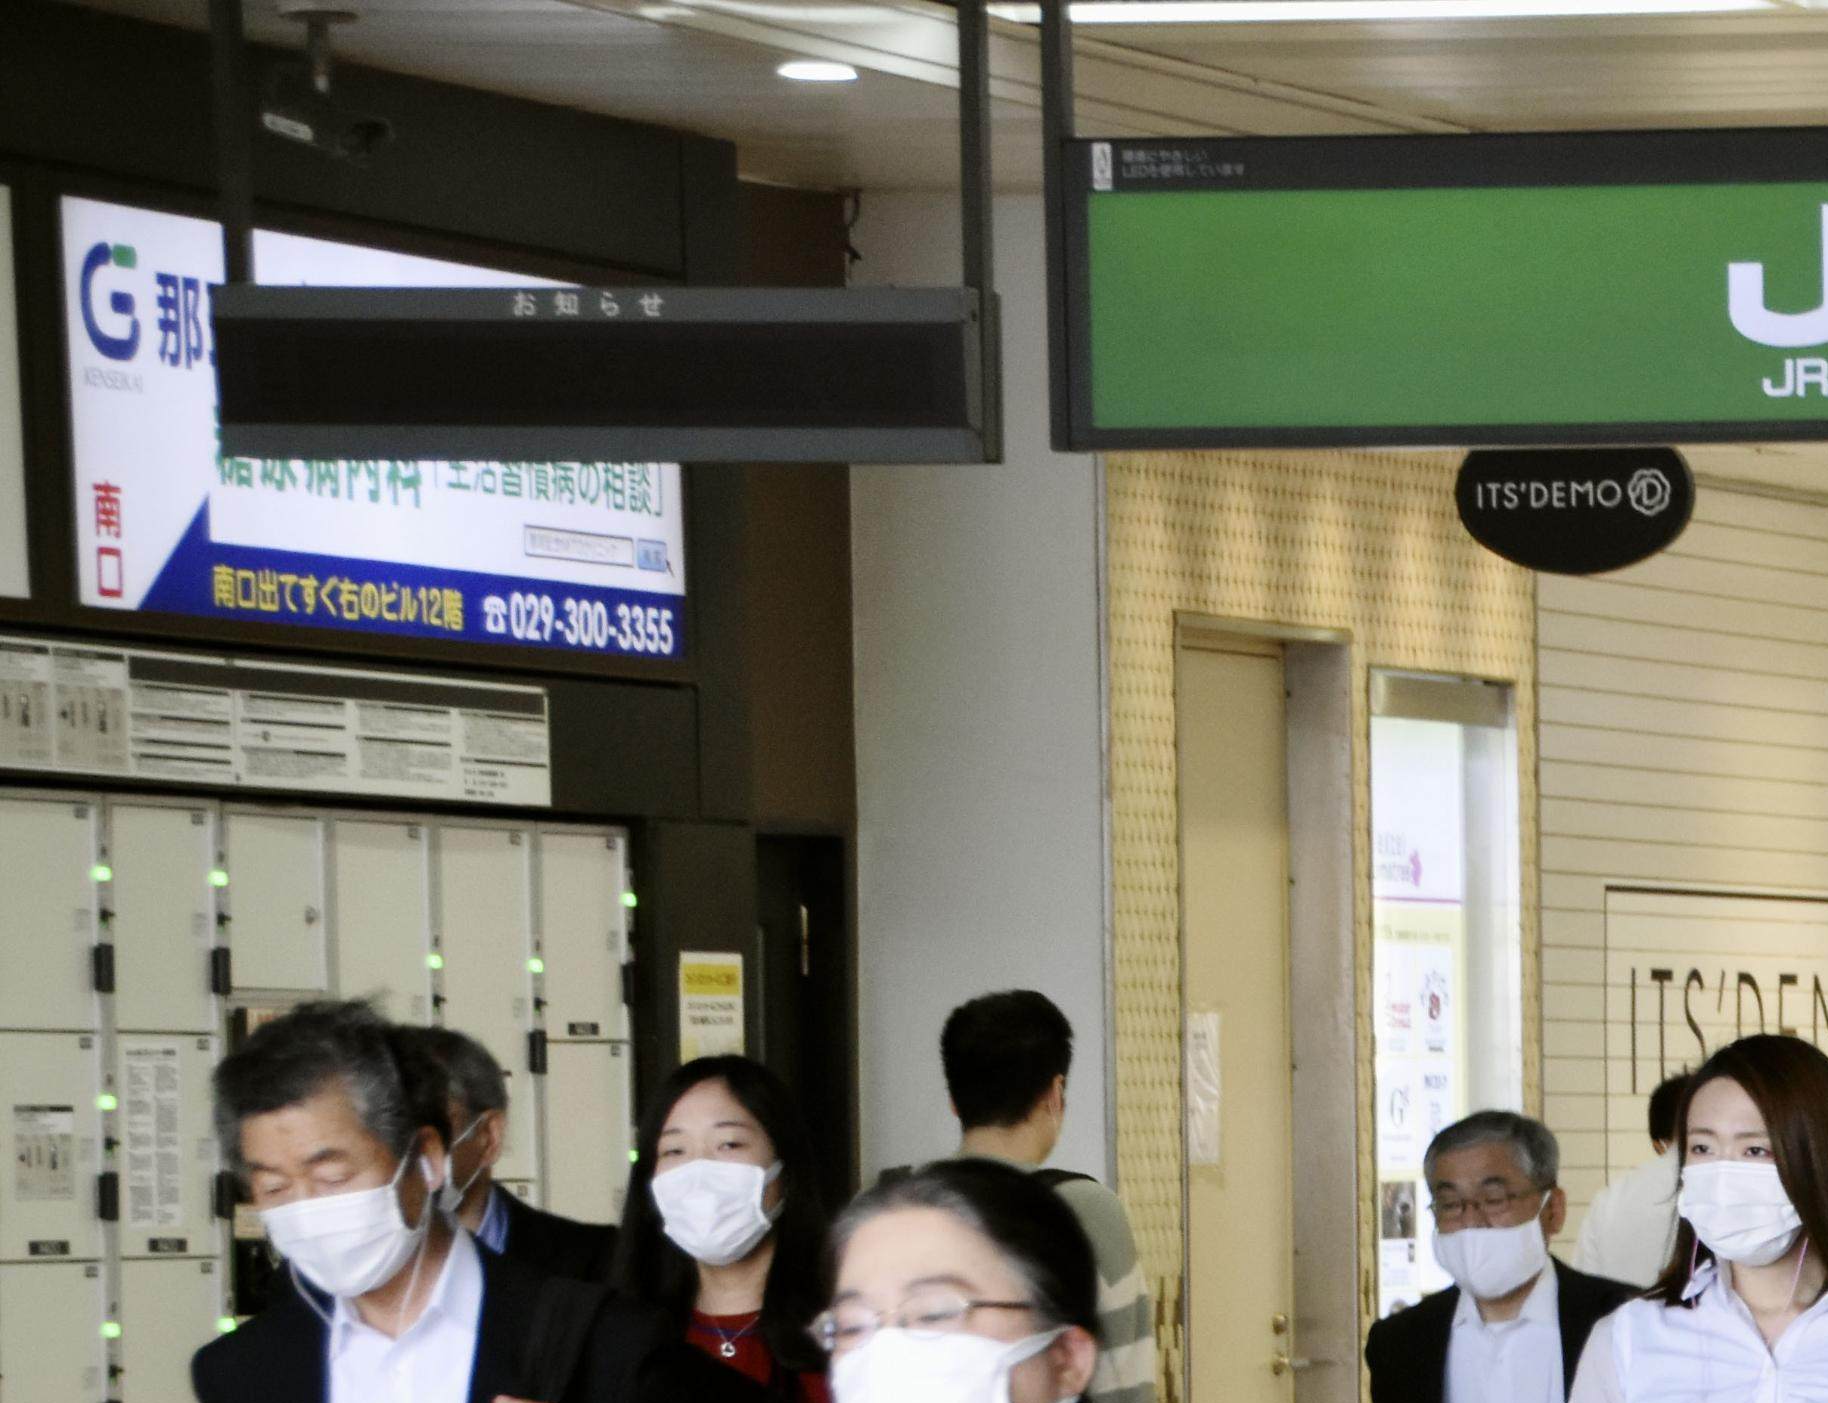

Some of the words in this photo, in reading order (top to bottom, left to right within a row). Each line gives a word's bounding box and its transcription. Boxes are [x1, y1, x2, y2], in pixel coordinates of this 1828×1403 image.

[155, 271, 214, 370] 那
[513, 290, 664, 318] お知らせ
[1477, 479, 1622, 510] ITS'DEMO
[92, 480, 124, 598] 南口
[511, 592, 674, 656] 029-300-3355
